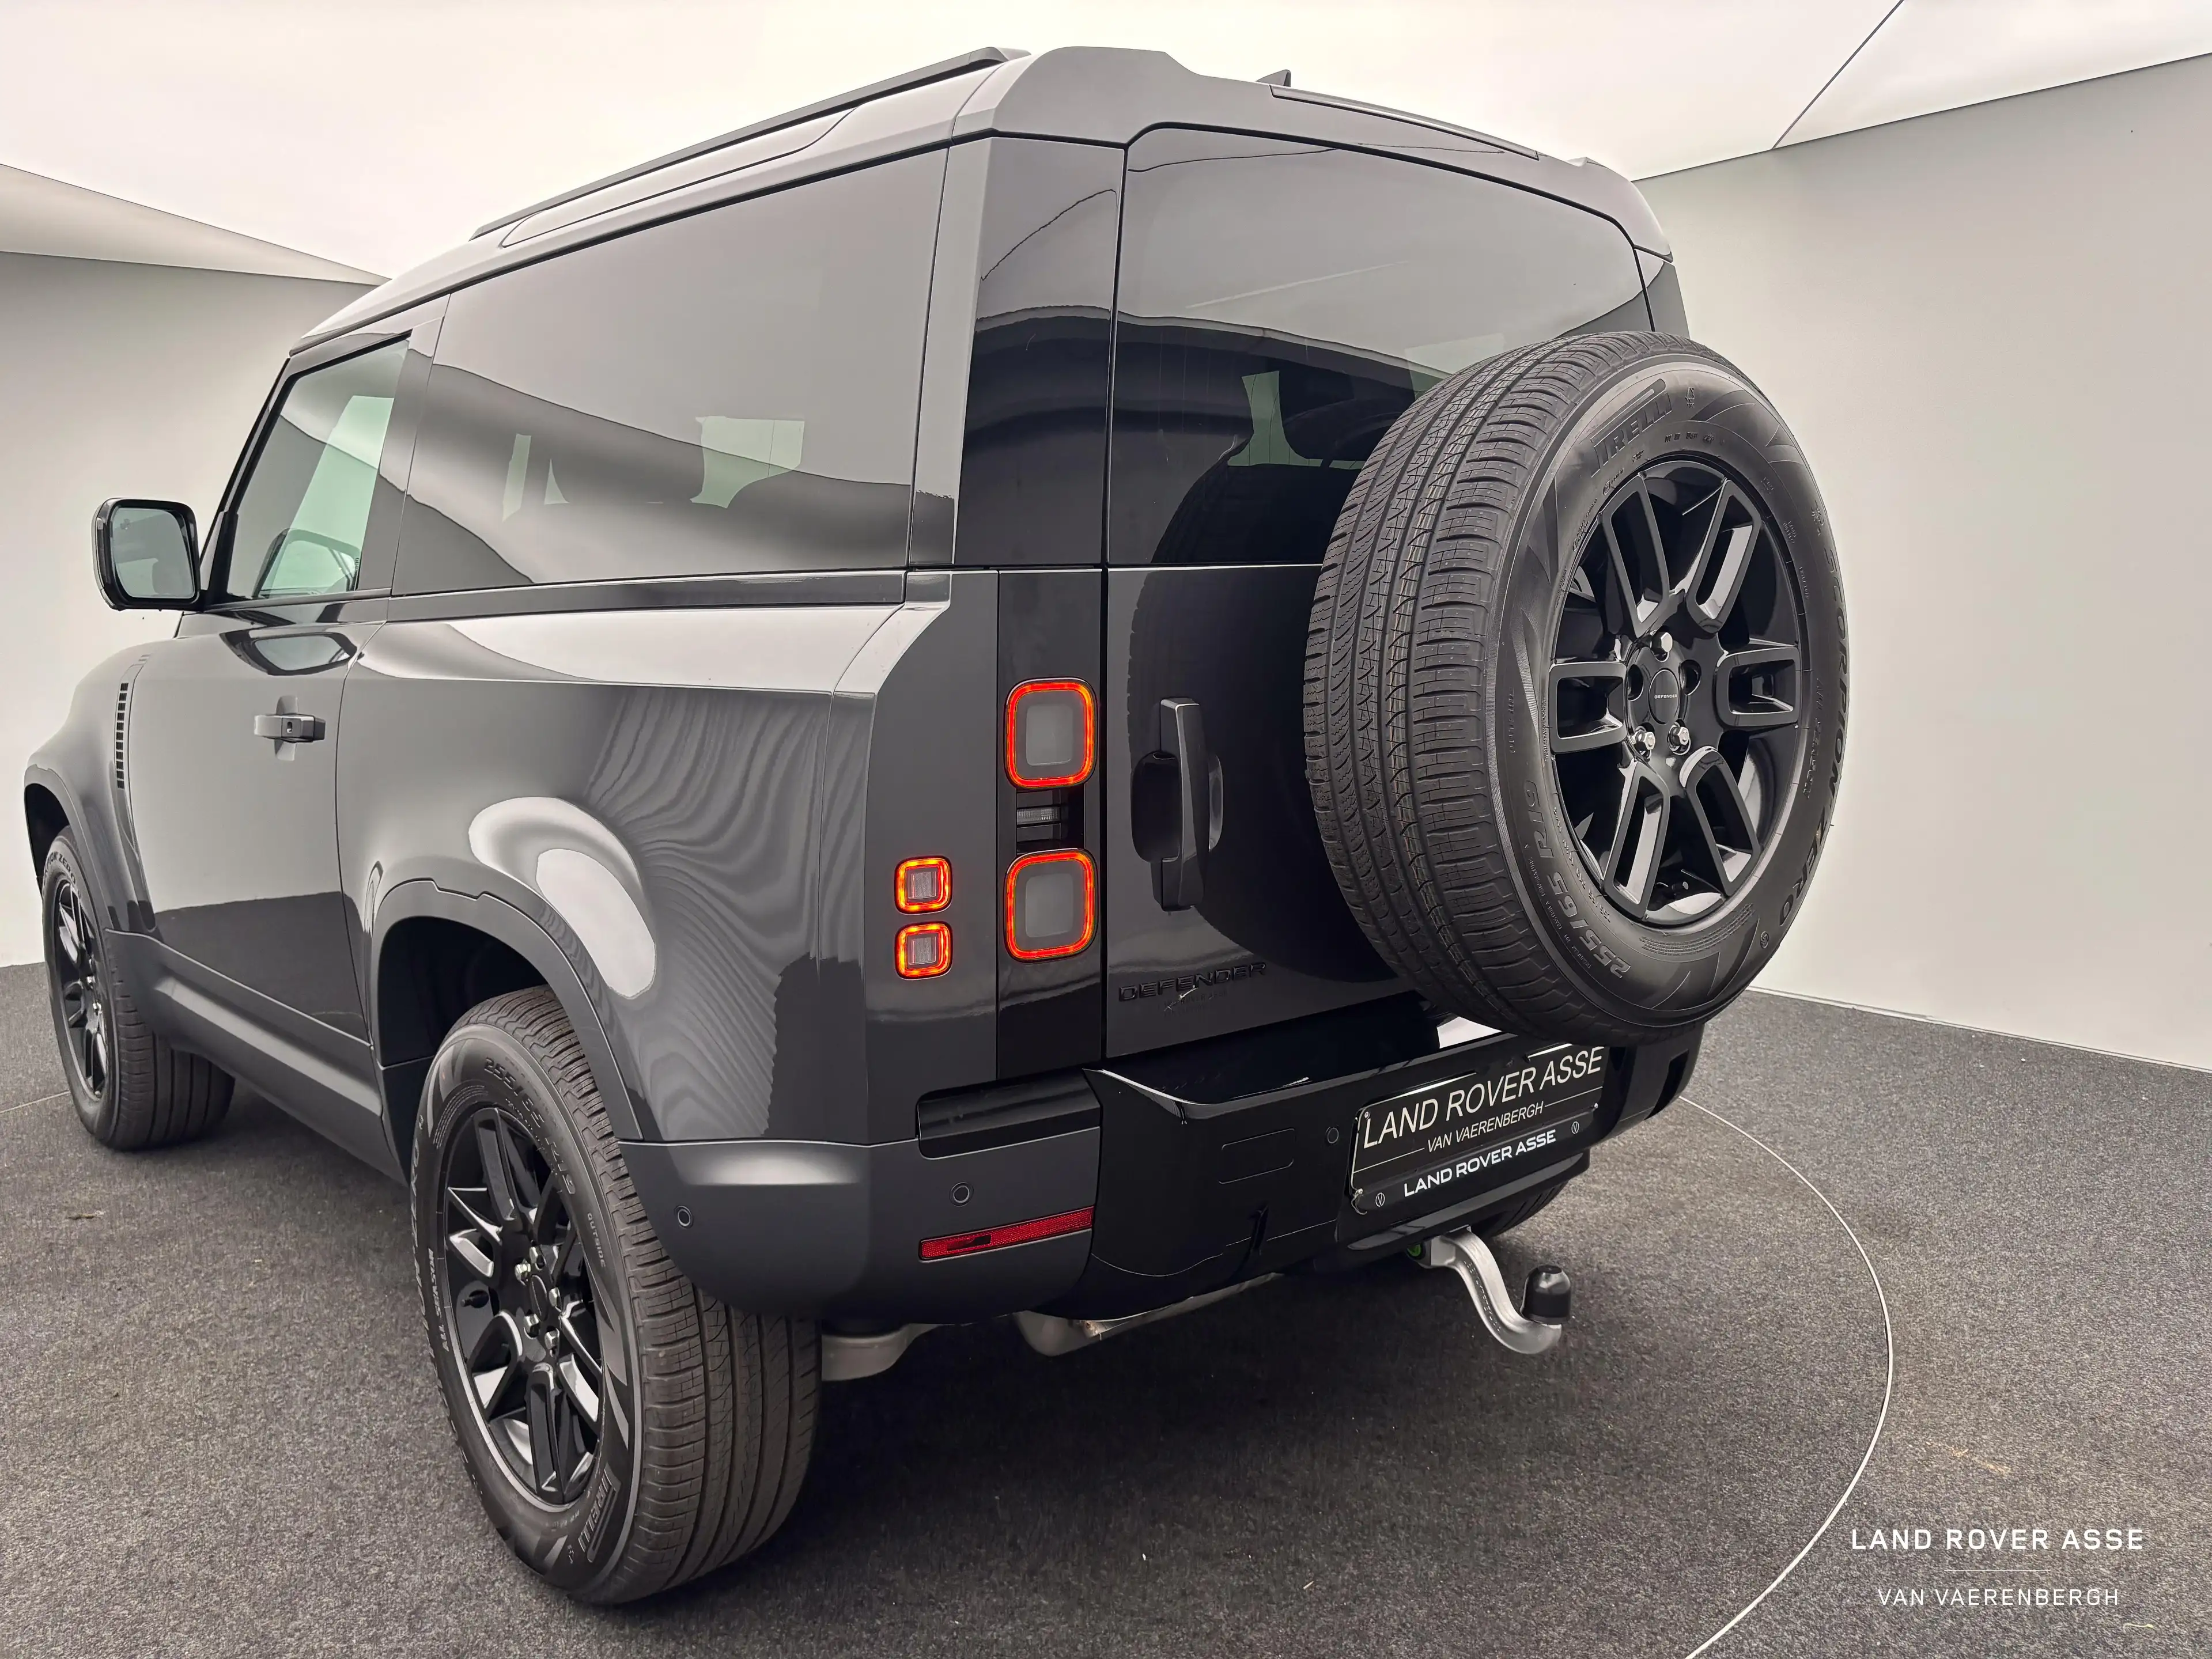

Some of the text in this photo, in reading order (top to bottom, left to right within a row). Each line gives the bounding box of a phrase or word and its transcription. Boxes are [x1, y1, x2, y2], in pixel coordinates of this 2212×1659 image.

[1118, 961, 1267, 1002] DEFENDER
[1363, 1046, 1605, 1149] LAND ROVER ASSE
[1427, 1101, 1544, 1153] VAN VAERENBERGH
[1404, 1129, 1556, 1197] LAND ROVER ASSE
